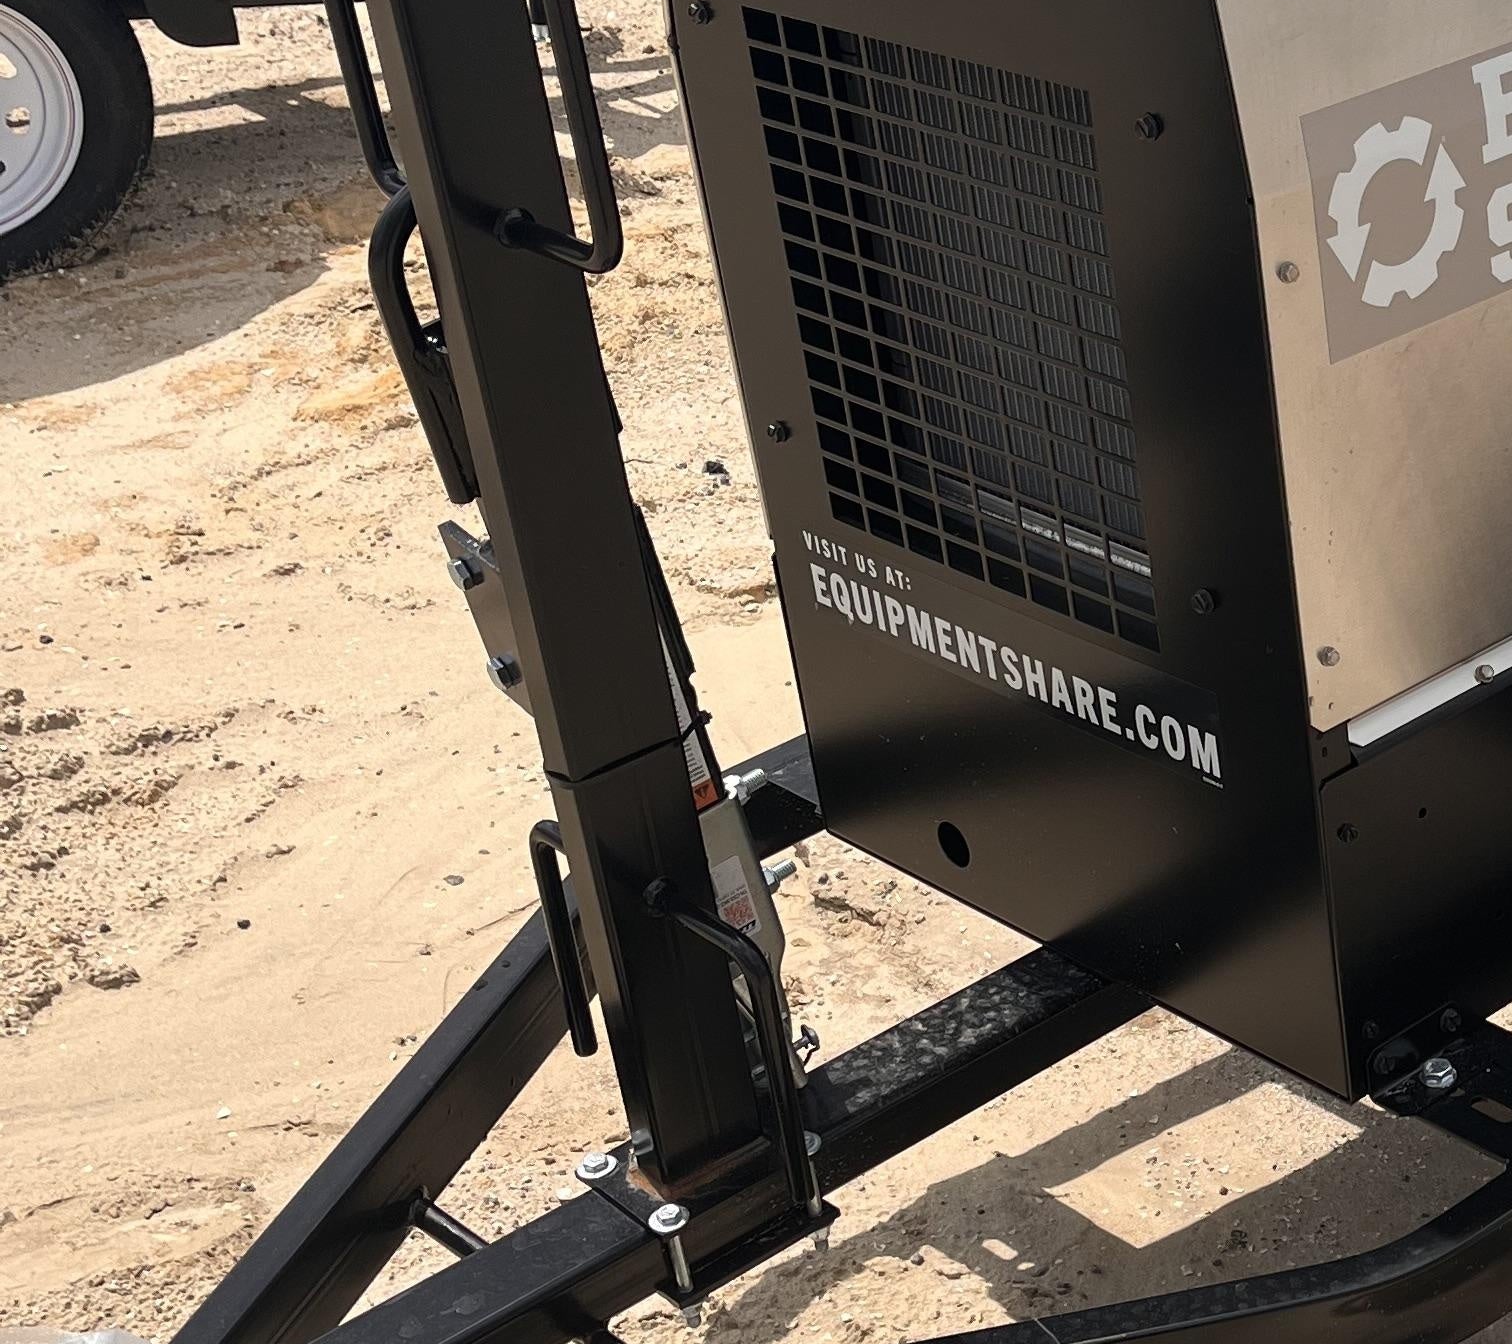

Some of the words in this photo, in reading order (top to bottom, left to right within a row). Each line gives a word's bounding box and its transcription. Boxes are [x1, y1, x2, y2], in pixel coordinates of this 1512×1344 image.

[802, 530, 848, 567] VISIT
[855, 552, 878, 579] US
[885, 566, 912, 592] AT:
[810, 563, 1222, 779] EQUIPMENTSHARE.COM
